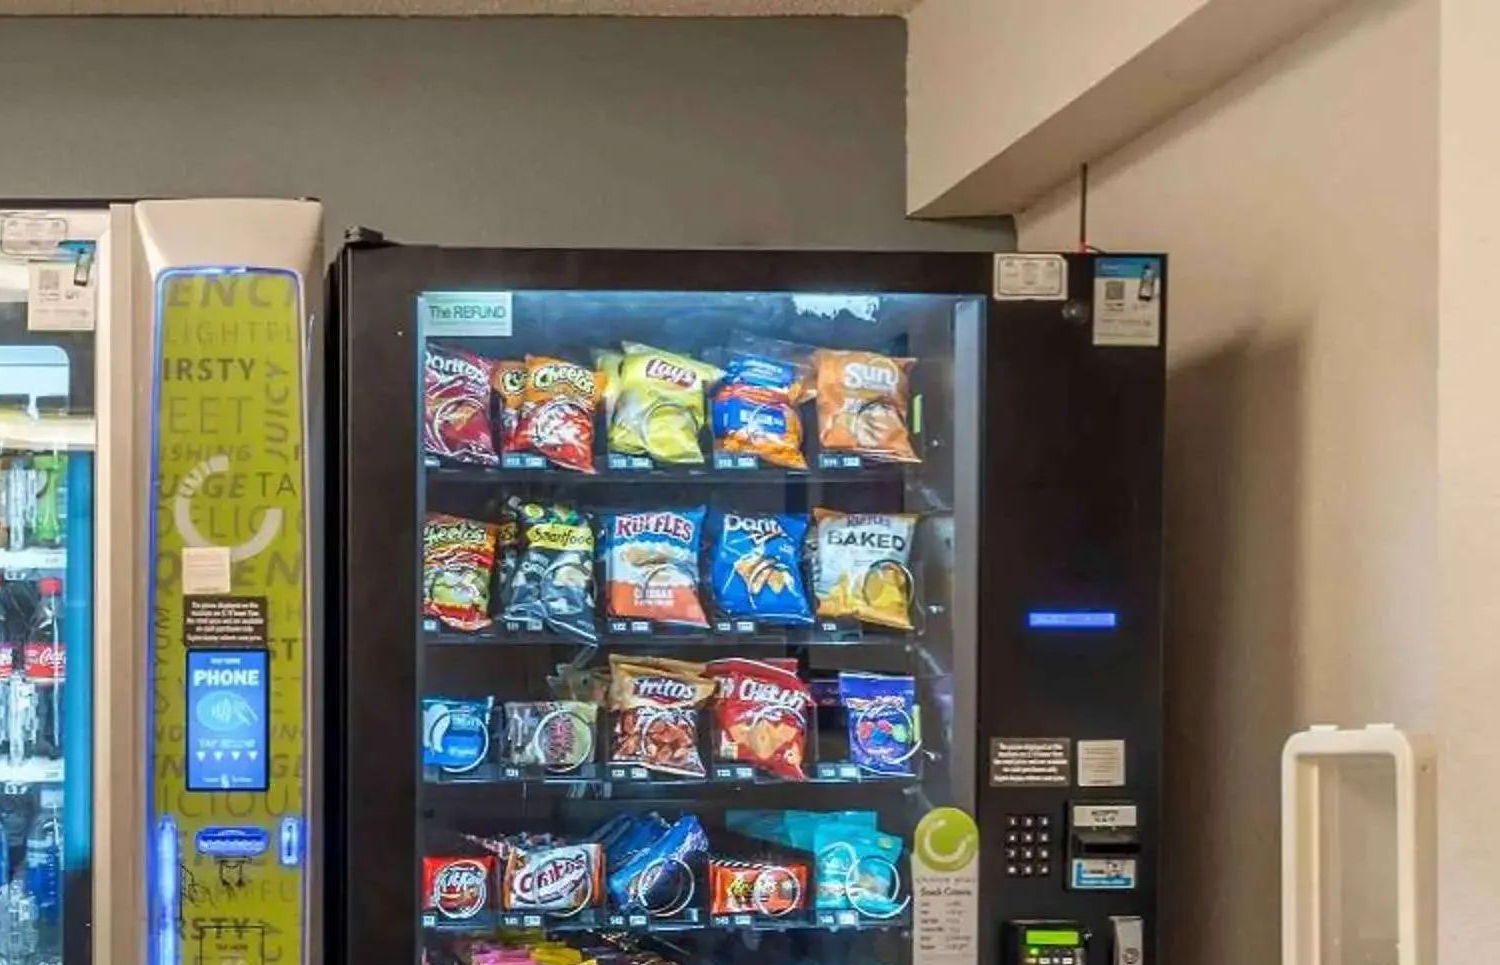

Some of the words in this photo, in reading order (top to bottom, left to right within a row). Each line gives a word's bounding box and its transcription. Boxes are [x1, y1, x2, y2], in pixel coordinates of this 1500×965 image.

[429, 304, 451, 318] The
[453, 305, 506, 319] REFUND
[827, 529, 906, 551] BAKED
[193, 668, 260, 687] PHONE
